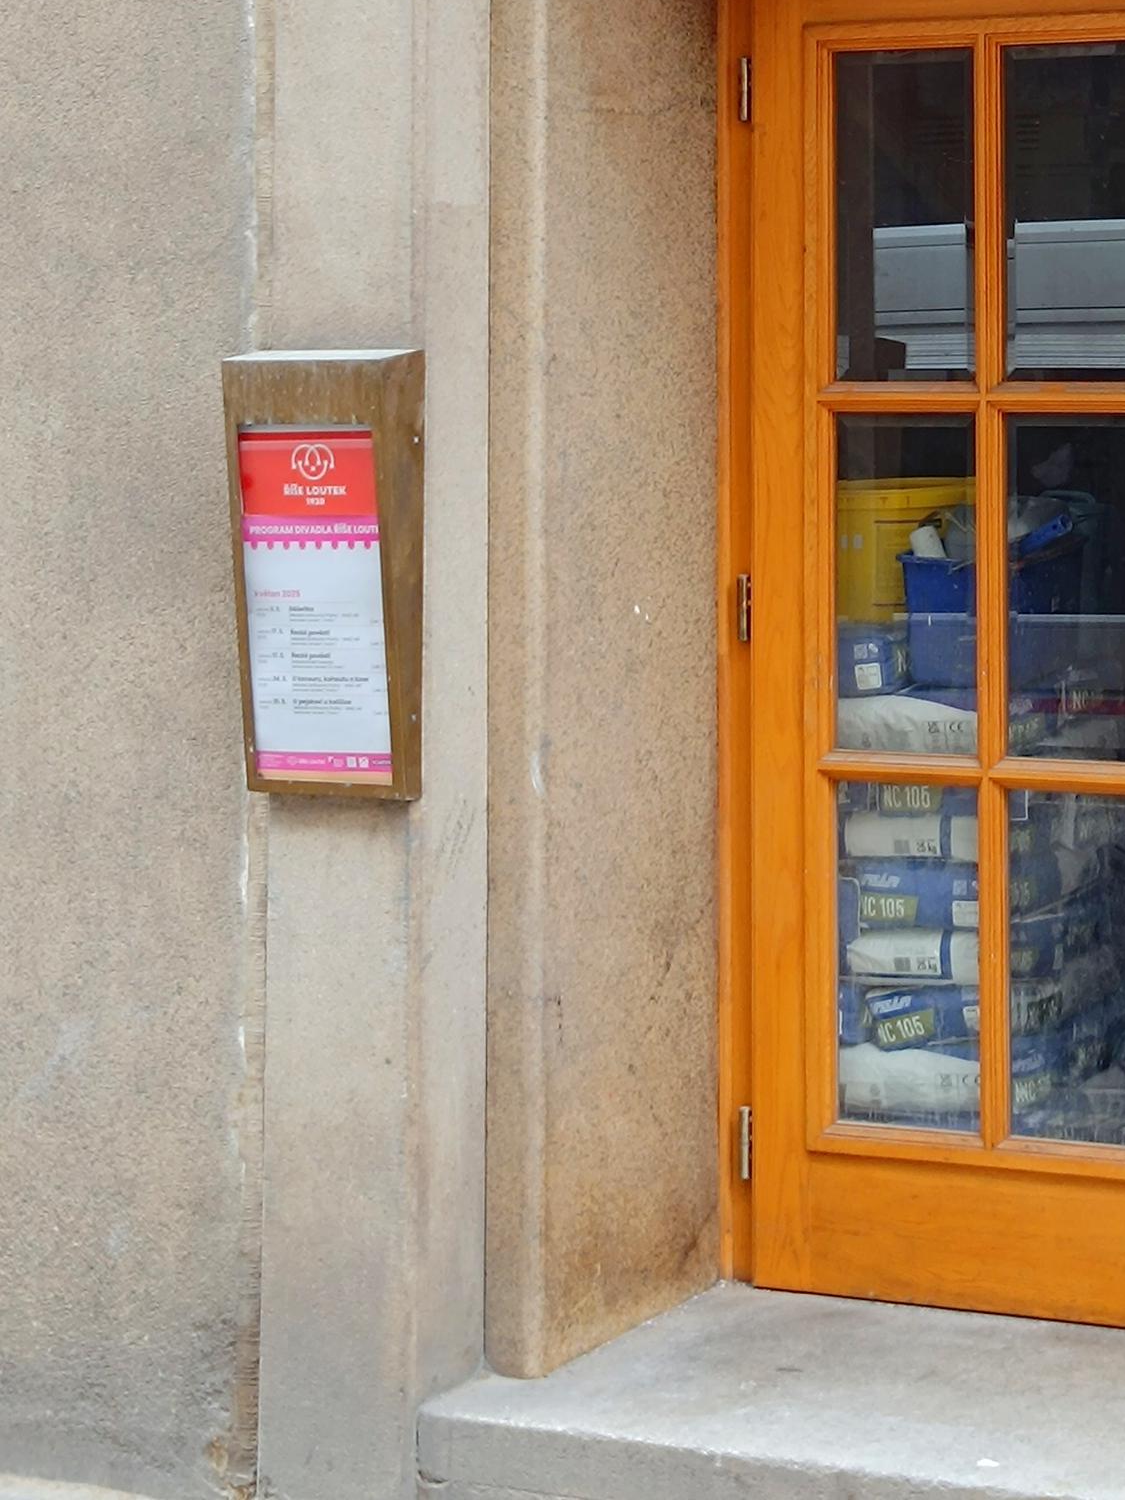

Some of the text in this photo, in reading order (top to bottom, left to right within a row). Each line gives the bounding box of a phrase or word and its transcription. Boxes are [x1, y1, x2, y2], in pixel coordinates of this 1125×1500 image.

[306, 485, 347, 496] LOUTEK
[249, 524, 293, 534] PROGRAM
[294, 524, 333, 534] DIVADLA
[883, 785, 901, 808] NC
[880, 897, 905, 918] 105
[896, 1015, 925, 1039] 105
